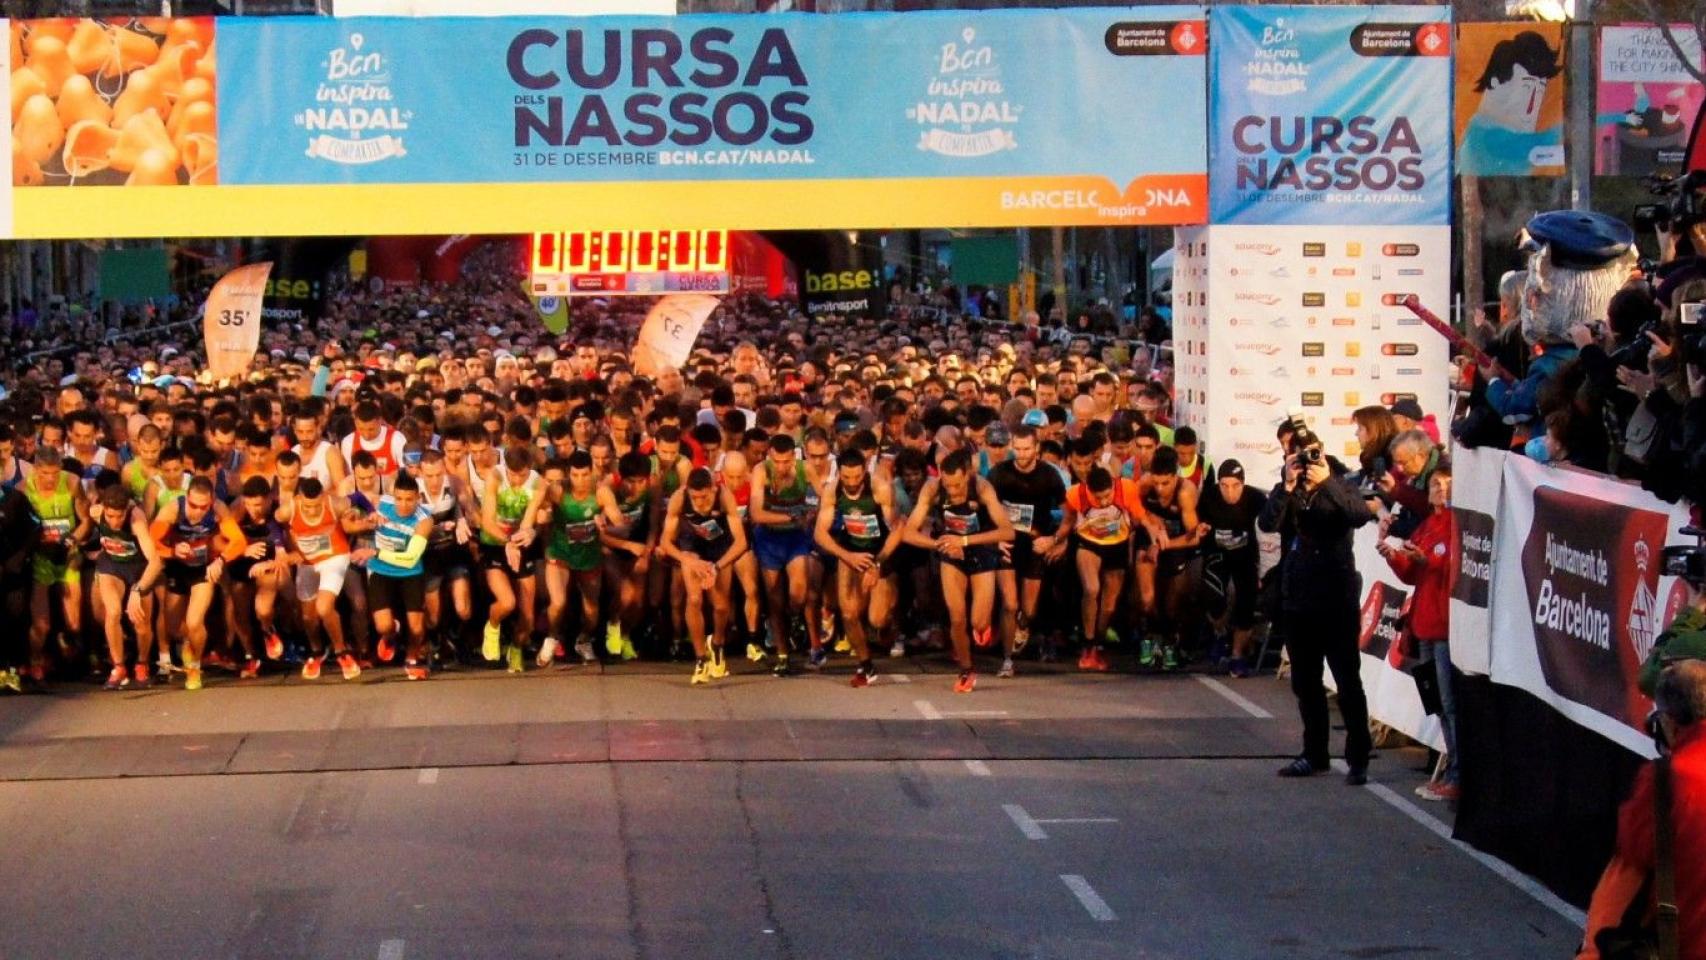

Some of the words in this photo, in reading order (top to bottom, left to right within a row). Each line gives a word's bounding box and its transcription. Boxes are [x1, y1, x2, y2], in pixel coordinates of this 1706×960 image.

[1116, 37, 1166, 48] Barcelona
[1117, 29, 1156, 38] Ajuntament
[1157, 29, 1166, 37] de
[1263, 27, 1295, 44] Bcn
[1362, 29, 1400, 38] Ajuntament
[1362, 38, 1411, 48] Barcelona
[328, 48, 381, 80] Bcn
[506, 27, 809, 90] CURSA
[941, 42, 991, 73] Bcn
[1609, 61, 1628, 72] THE
[1632, 61, 1656, 72] CITY
[316, 83, 393, 105] inspira
[928, 78, 1004, 99] inspira
[514, 95, 545, 105] DELS
[514, 91, 815, 147] NASSOS
[1232, 115, 1422, 155] CURSA
[514, 153, 528, 166] 31
[535, 153, 557, 166] DE
[564, 152, 657, 166] DESEMBRE
[659, 149, 815, 166] BCN.CAT/NADAL
[1236, 156, 1425, 191] NASSOS
[1098, 203, 1147, 218] inspira
[264, 279, 320, 299] ase:
[1545, 531, 1597, 582] Ajuntament
[1597, 549, 1608, 587] de
[1535, 578, 1610, 651] Barcelona
